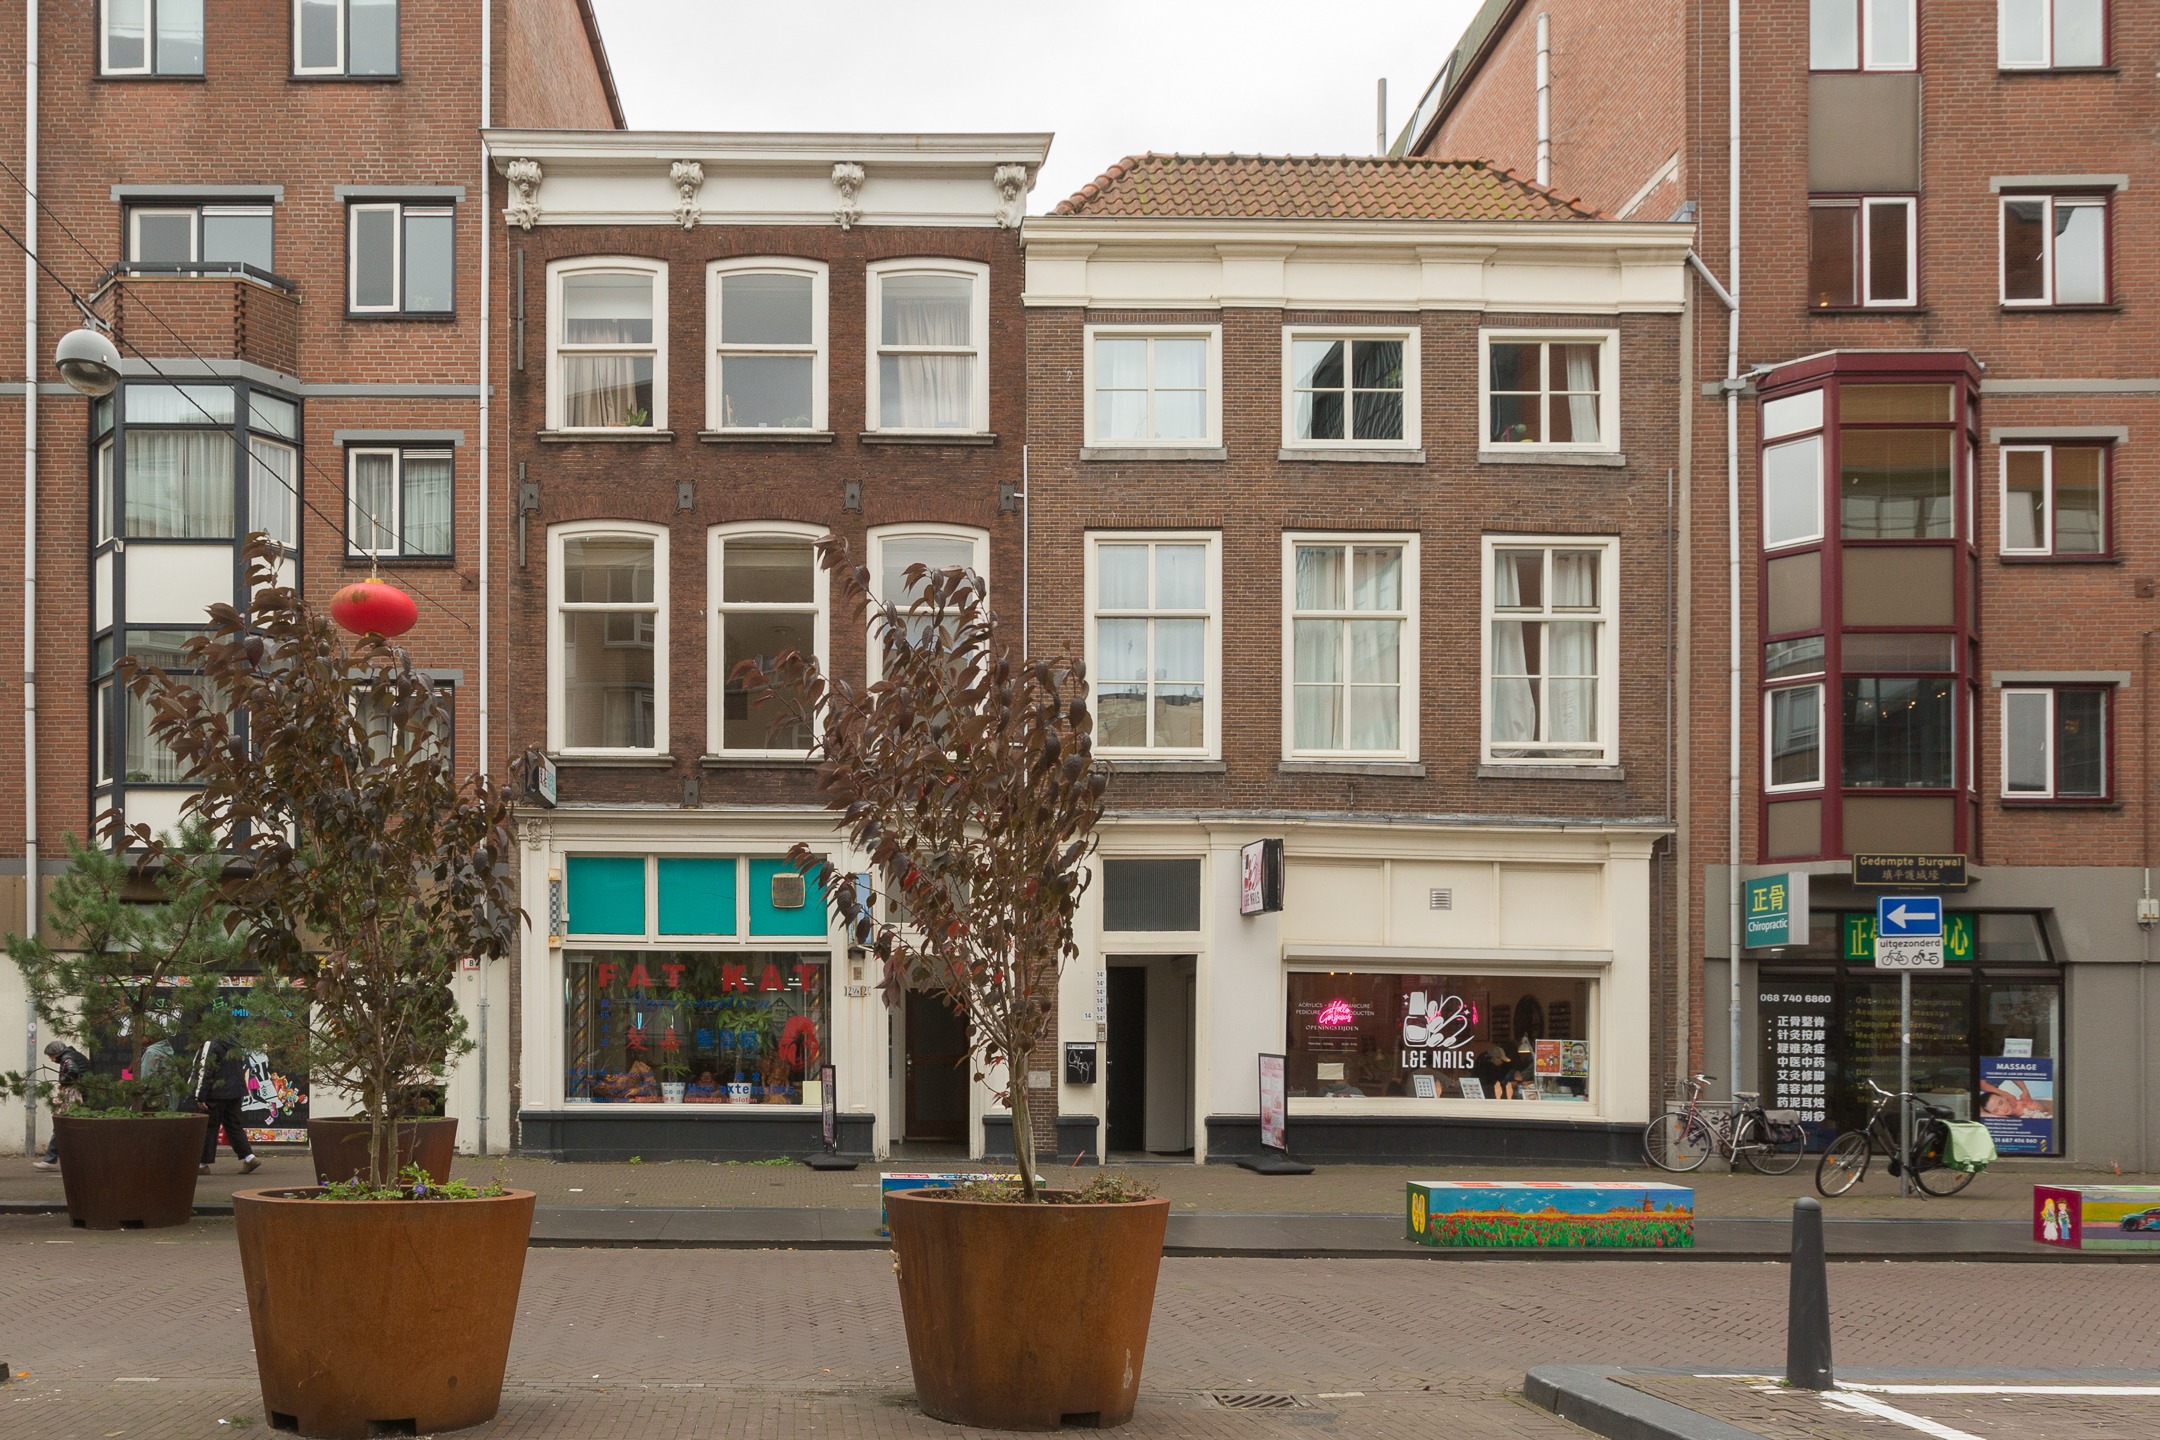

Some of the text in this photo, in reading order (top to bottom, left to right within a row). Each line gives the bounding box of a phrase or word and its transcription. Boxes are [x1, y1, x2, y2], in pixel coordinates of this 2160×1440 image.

[1860, 857, 1961, 869] Gedempte Burgwal
[1752, 884, 1785, 912] 正骨
[1748, 918, 1788, 932] Chiropractic
[1880, 940, 1940, 950] uitgezonderd
[598, 963, 818, 993] FAT KAT
[1760, 994, 1831, 1003] 068 740 6860
[1777, 1015, 1825, 1027] 正骨整脊
[1777, 1029, 1826, 1041] 针灸按摩
[1777, 1043, 1826, 1054] 疑难杂症
[1402, 1050, 1475, 1069] L&E NAILS
[1777, 1056, 1826, 1068] 中医中药
[1996, 1063, 2037, 1071] MASSAGE
[1777, 1070, 1826, 1081] 艾灸修脚
[719, 1083, 795, 1095] extensions
[1777, 1083, 1826, 1095] 美容减肥
[1777, 1096, 1826, 1108] 药泥耳烛
